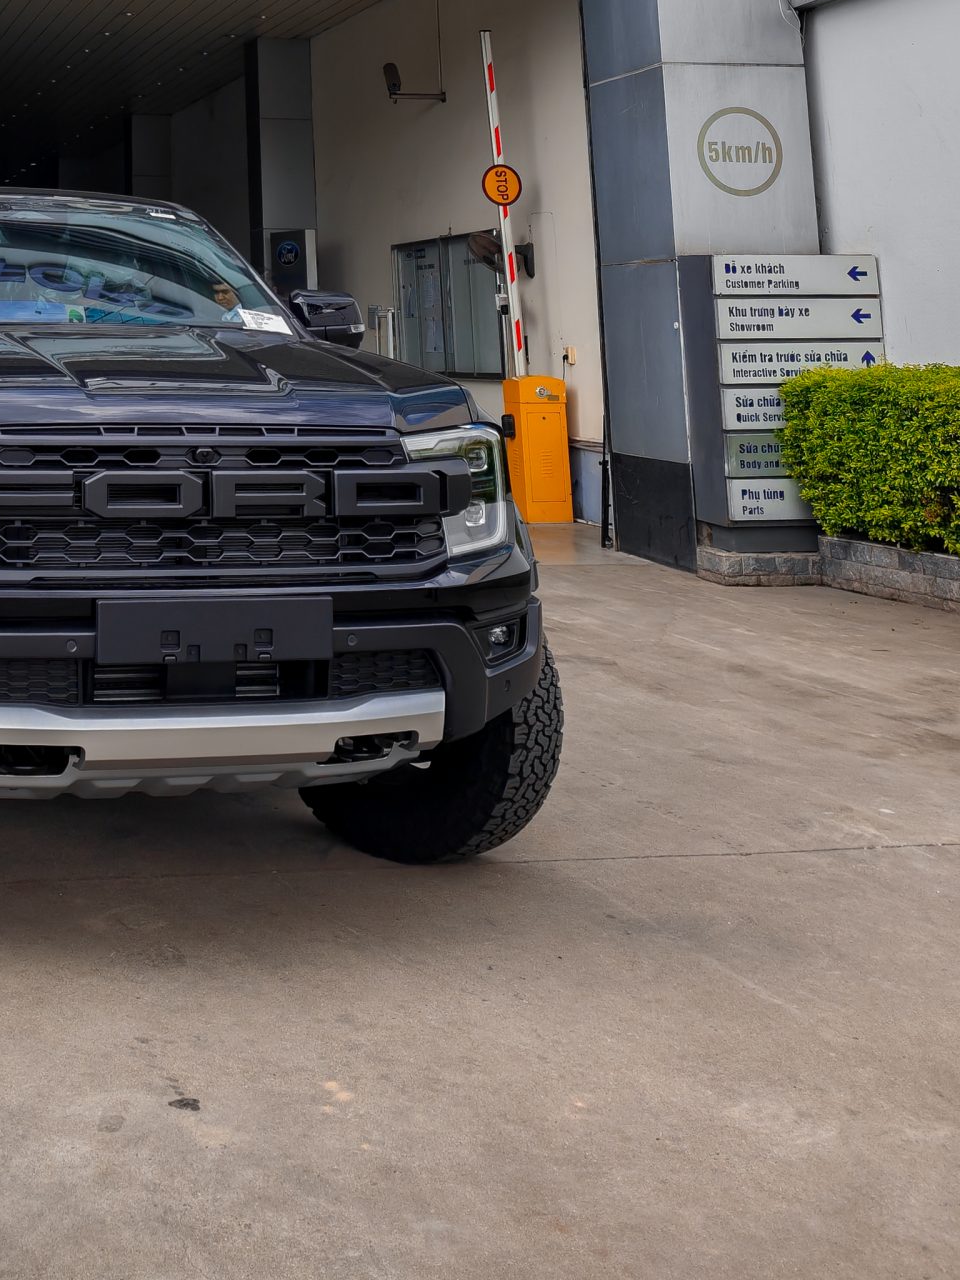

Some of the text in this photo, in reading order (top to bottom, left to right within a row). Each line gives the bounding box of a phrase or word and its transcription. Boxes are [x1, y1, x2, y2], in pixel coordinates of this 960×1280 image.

[707, 140, 774, 165] 5km/h
[495, 170, 509, 201] STOP
[740, 264, 752, 274] xe
[755, 263, 785, 275] khách
[725, 279, 800, 290] Customer Parking
[728, 306, 747, 317] Khu
[750, 306, 775, 319] trưng
[798, 307, 810, 317] xe
[729, 322, 774, 332] Showroom
[760, 352, 773, 363] tra
[732, 368, 777, 378] Interactive
[736, 413, 760, 423] Quick
[740, 459, 780, 470] Body and
[741, 488, 785, 503] Phụ tùng
[742, 506, 765, 515] Parts
